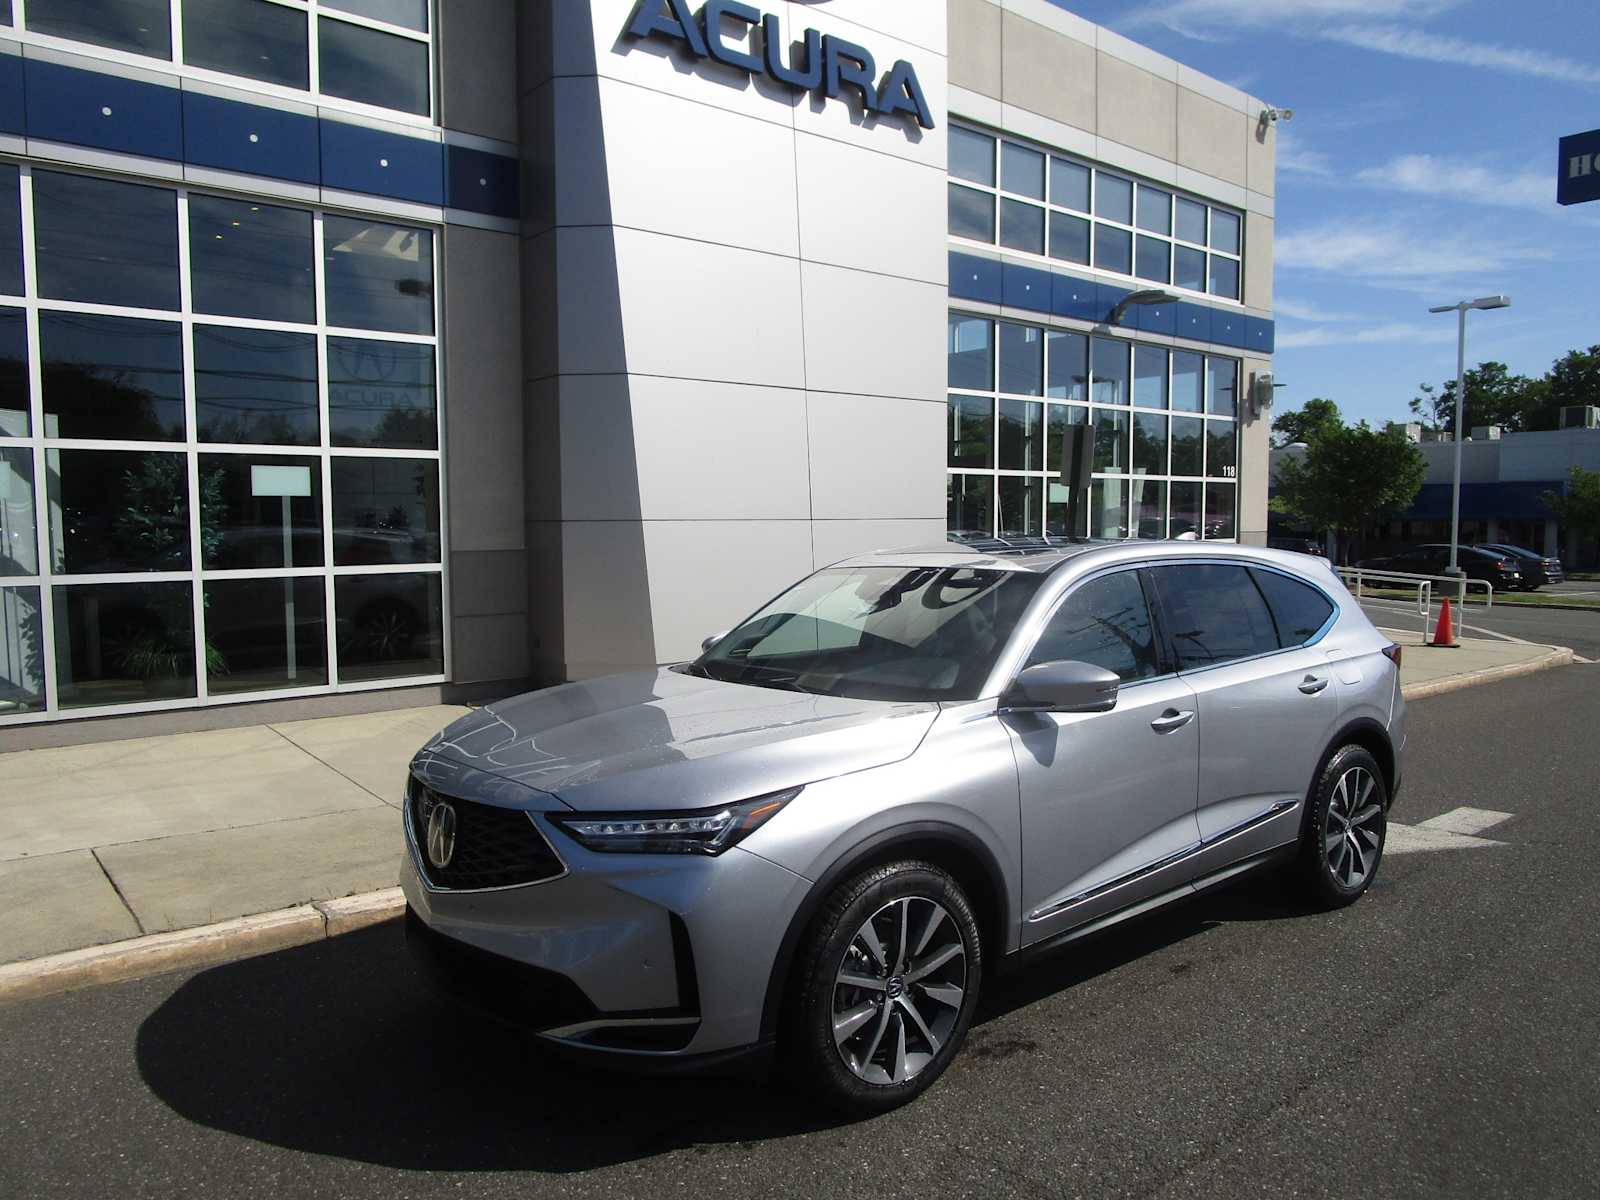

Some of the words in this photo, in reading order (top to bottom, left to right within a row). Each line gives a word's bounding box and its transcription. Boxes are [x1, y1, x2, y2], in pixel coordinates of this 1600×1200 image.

[627, 0, 935, 130] ACURA
[1569, 153, 1600, 178] H
[1222, 465, 1236, 477] 118
